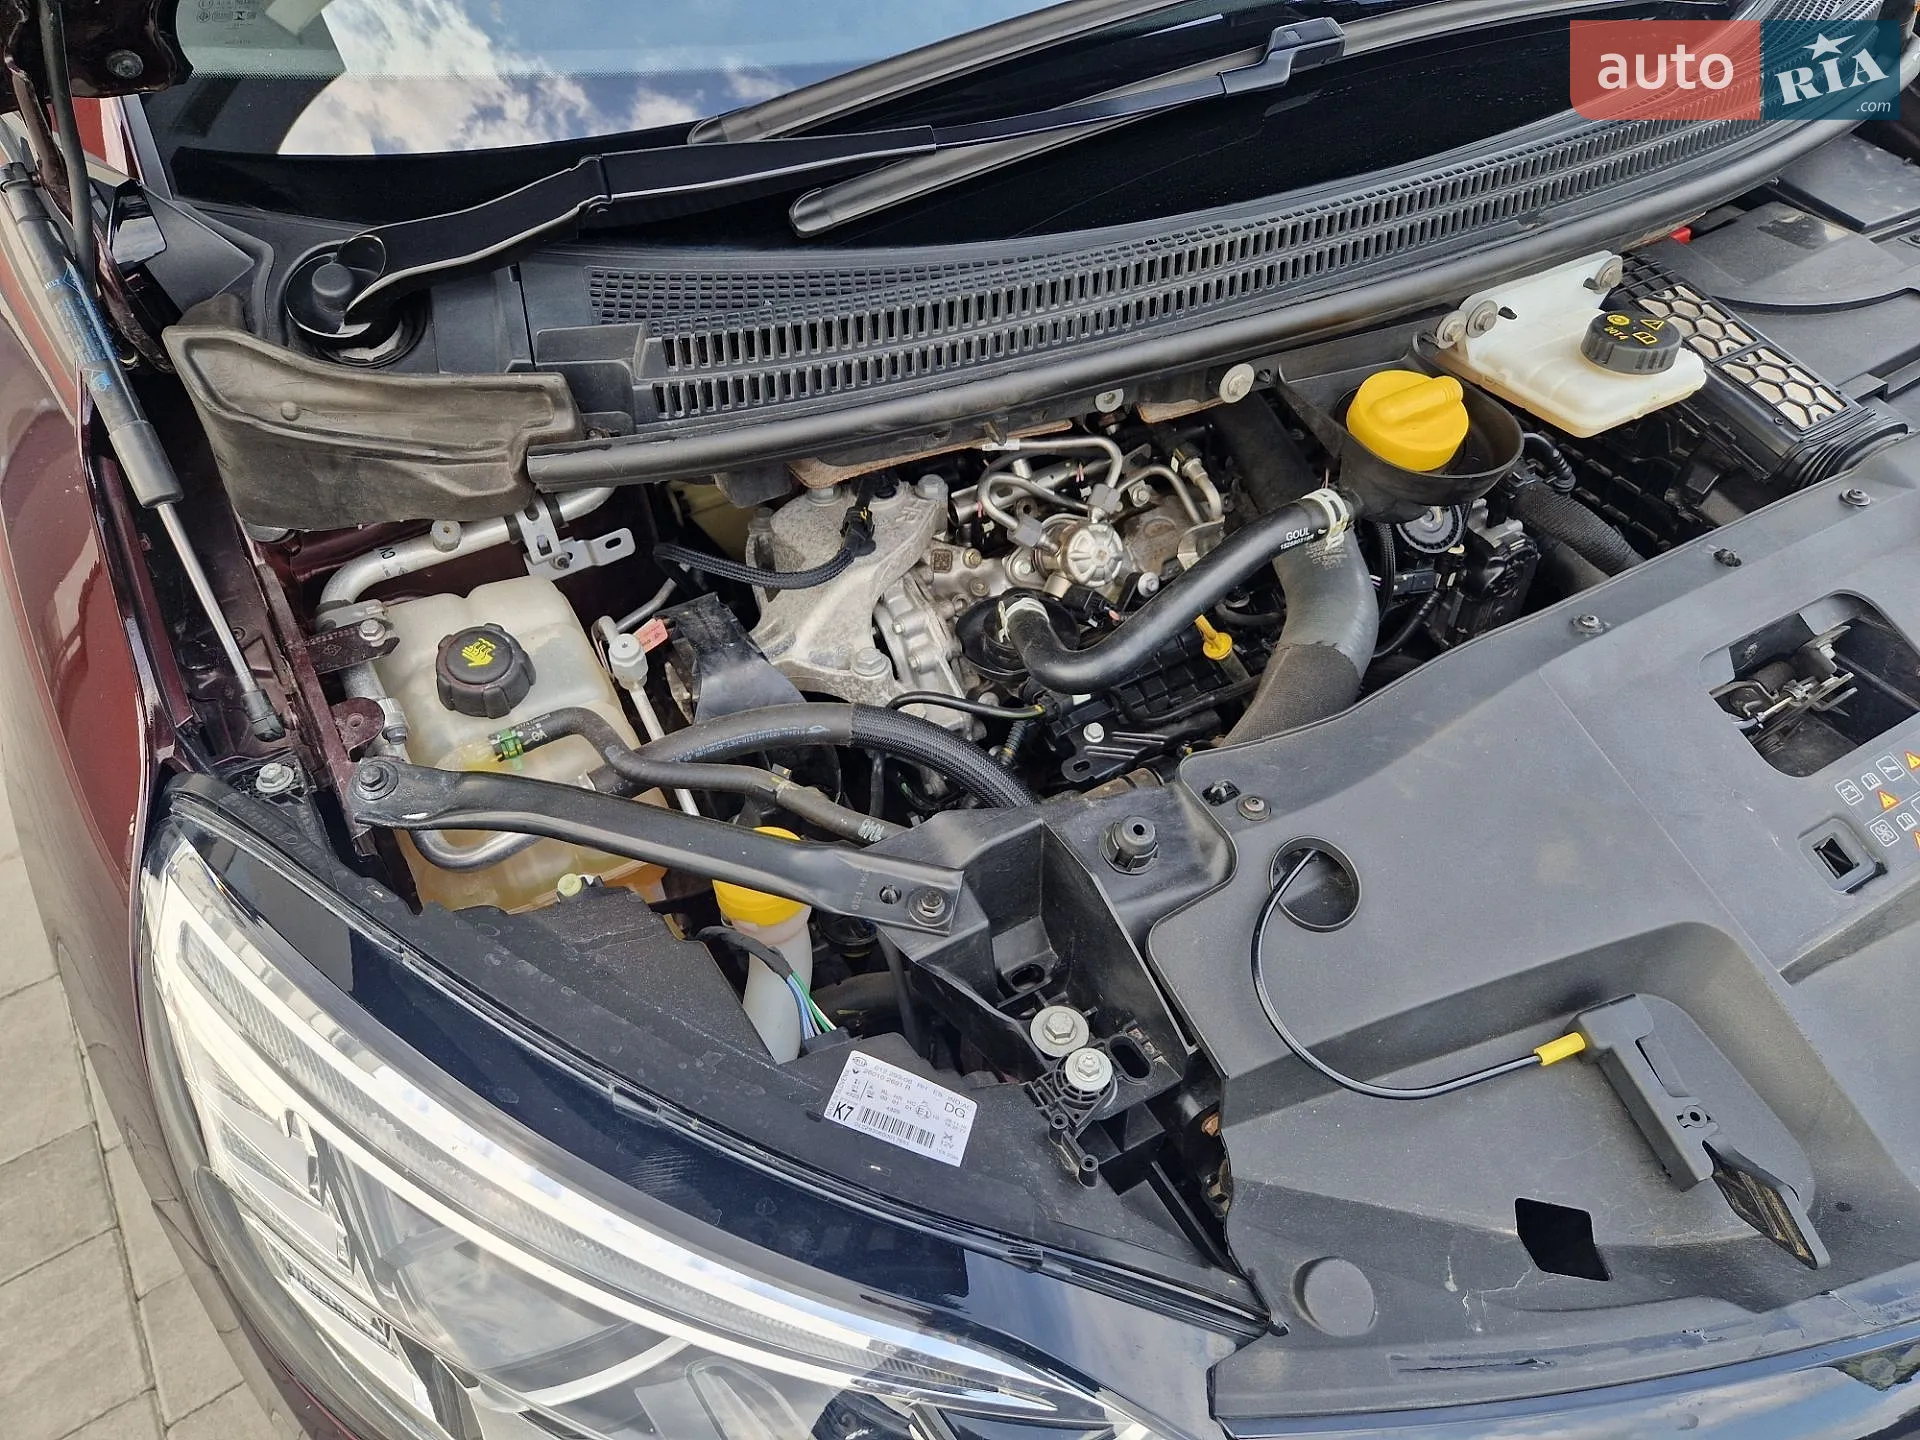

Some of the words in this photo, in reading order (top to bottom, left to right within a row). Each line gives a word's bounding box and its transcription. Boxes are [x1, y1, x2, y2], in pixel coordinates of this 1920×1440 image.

[1286, 527, 1310, 541] GOUL
[833, 1101, 854, 1122] K7
[944, 1102, 966, 1118] DG
